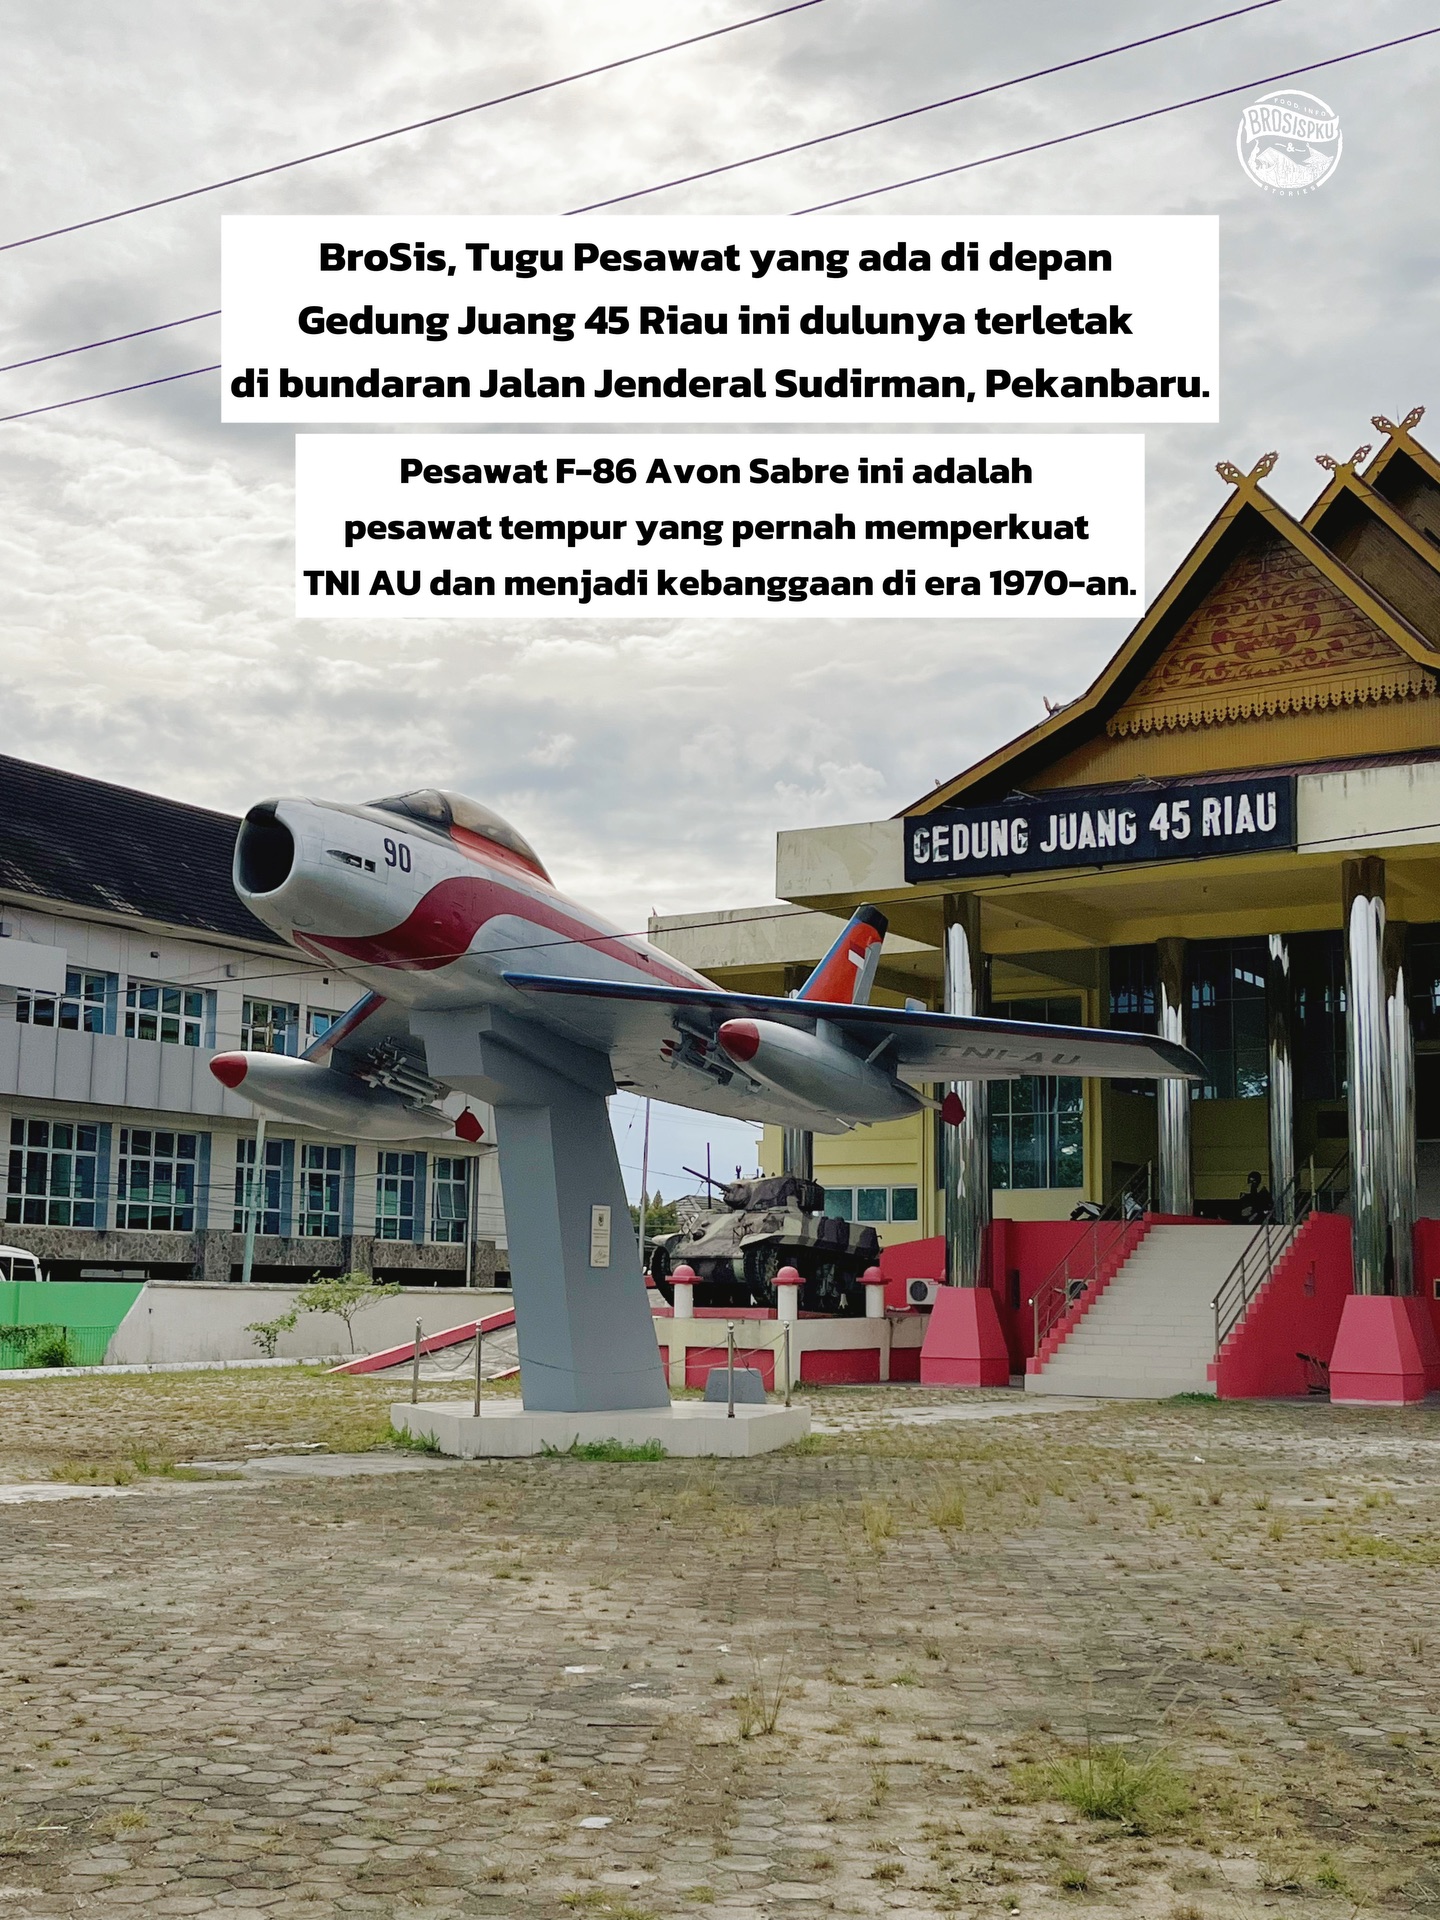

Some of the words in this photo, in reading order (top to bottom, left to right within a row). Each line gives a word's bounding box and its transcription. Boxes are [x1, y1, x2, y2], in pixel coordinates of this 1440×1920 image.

[913, 817, 1028, 864] GEDUNG
[1040, 807, 1137, 853] JUANG
[1149, 800, 1191, 841] 45
[1202, 791, 1277, 837] RIAU
[383, 837, 411, 873] 90
[935, 1044, 1081, 1065] TNI-AU
